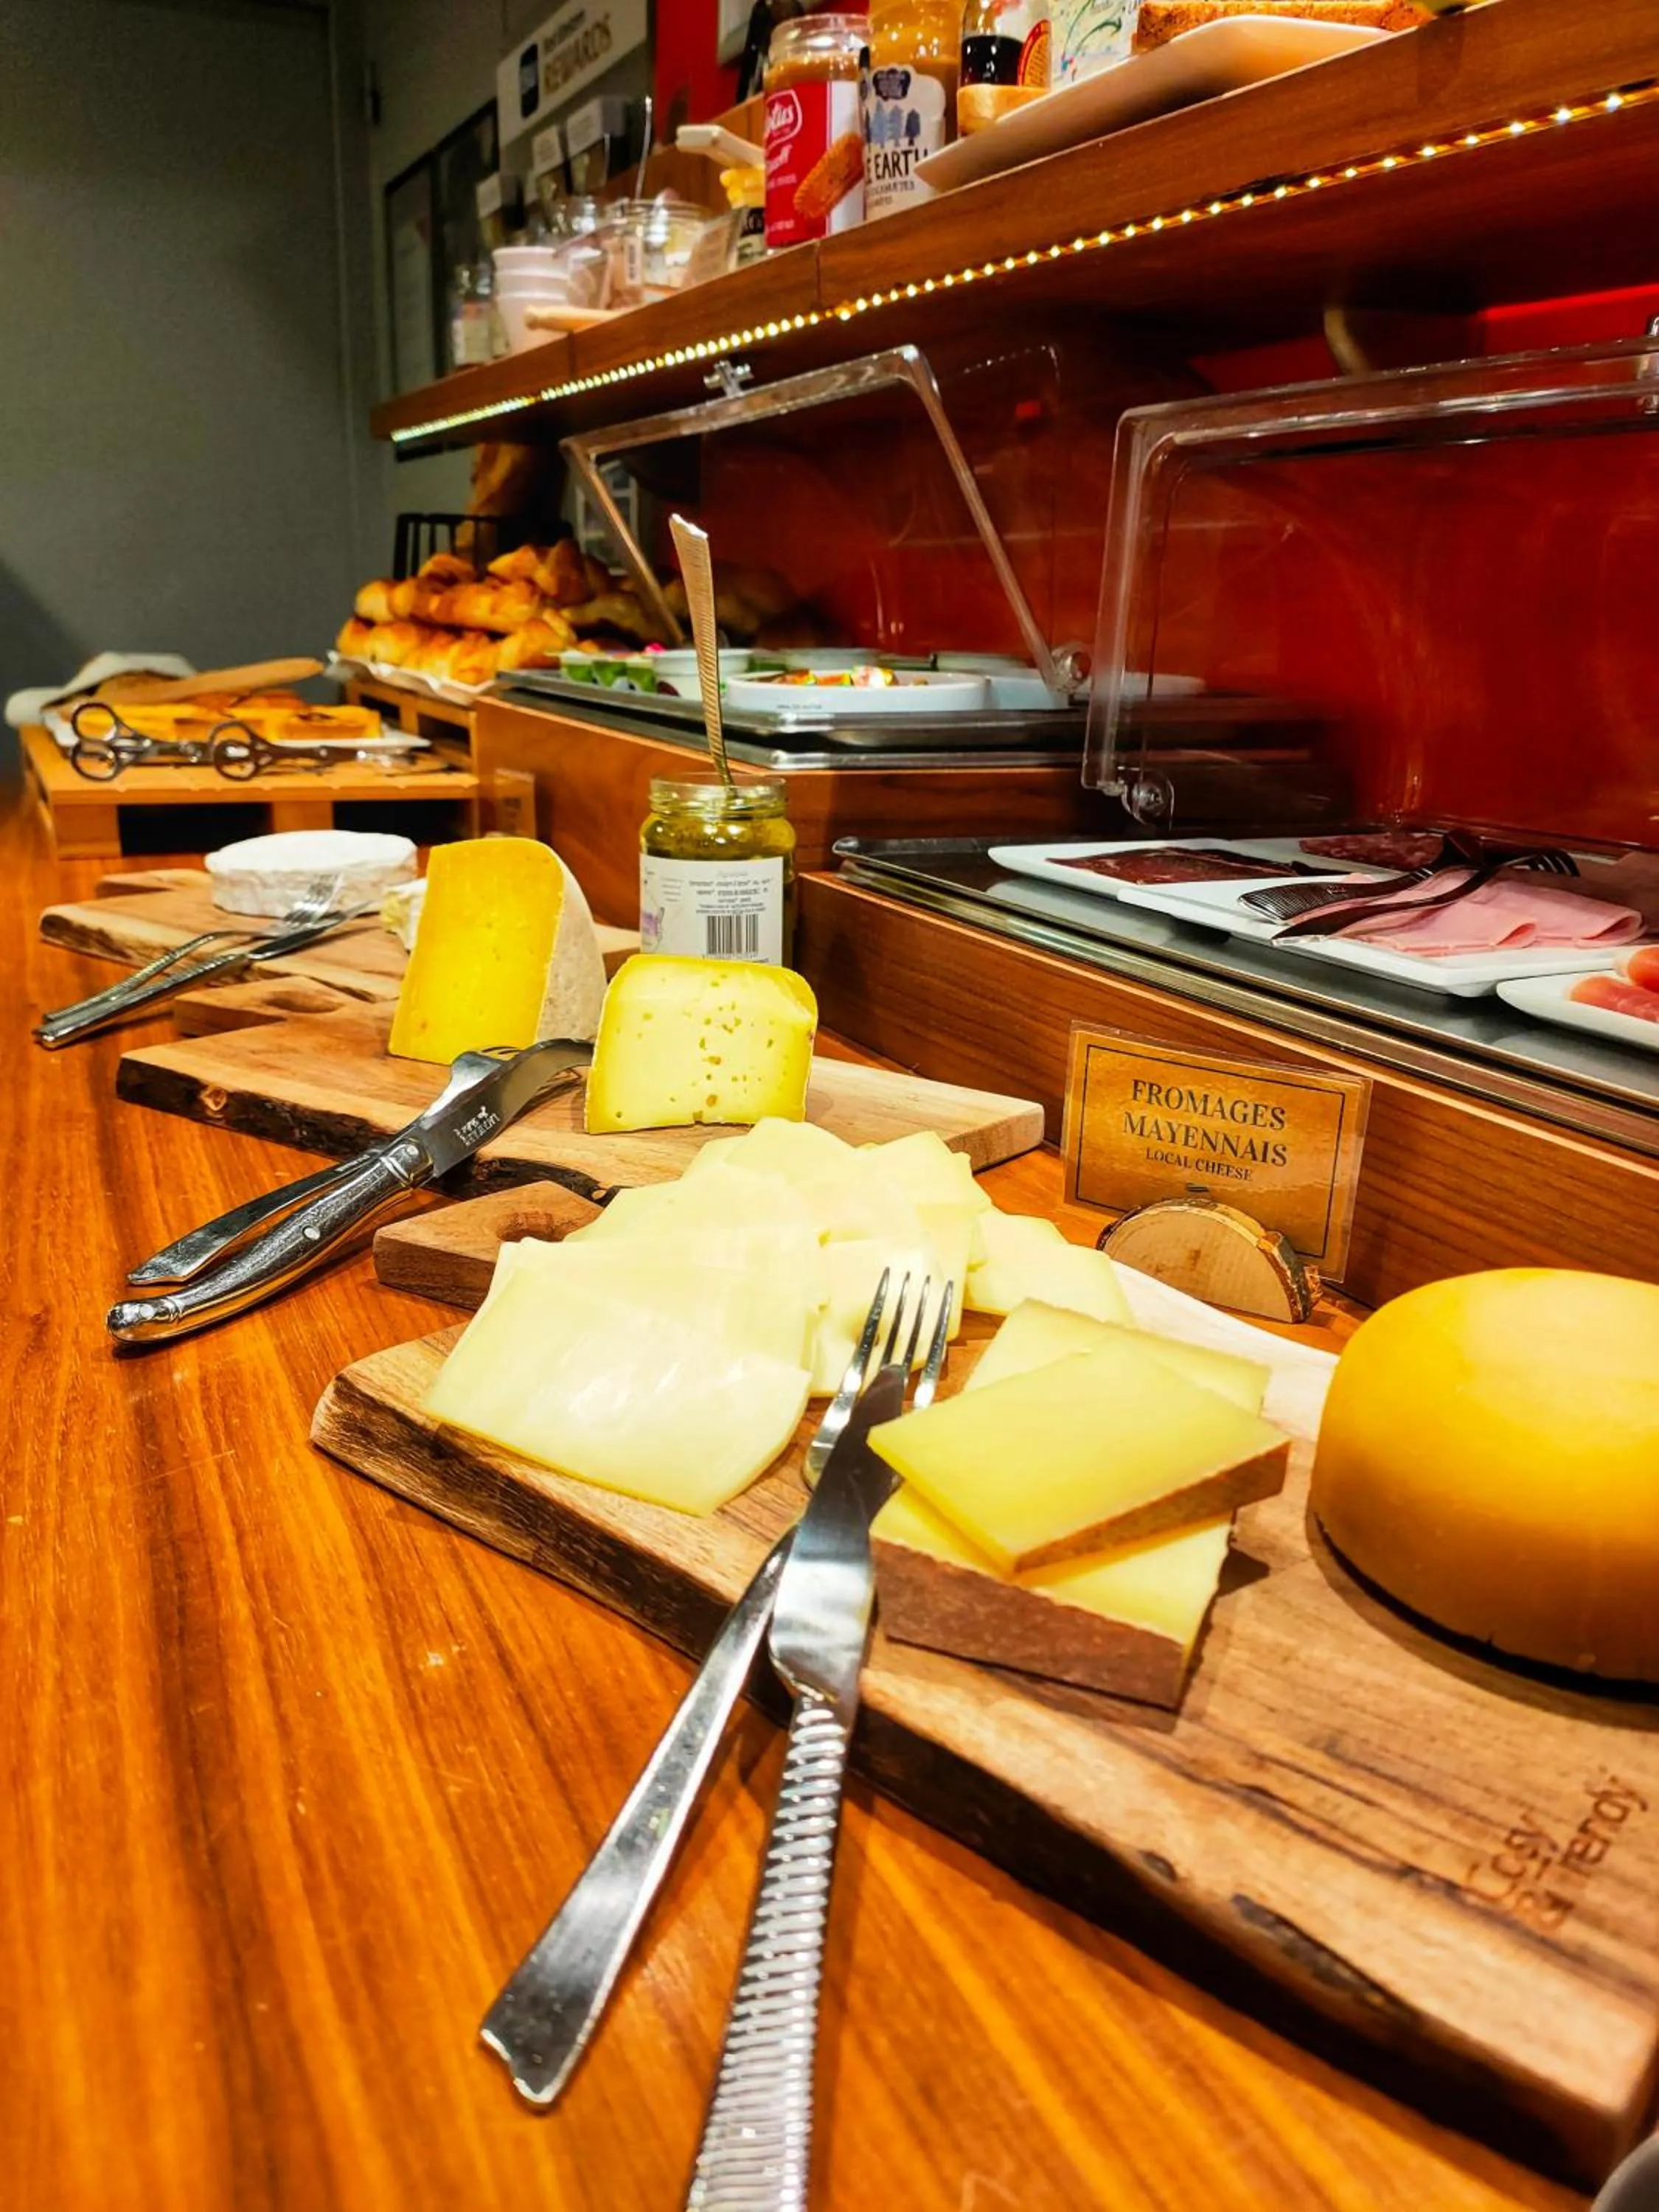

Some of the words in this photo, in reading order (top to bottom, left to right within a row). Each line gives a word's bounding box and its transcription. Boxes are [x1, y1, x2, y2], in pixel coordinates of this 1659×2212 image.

[1133, 1079, 1286, 1130] FROMAGES
[1122, 1111, 1288, 1167] MAYENNAIS
[1145, 1147, 1192, 1170] LOCAL
[1194, 1157, 1253, 1181] CHEESE
